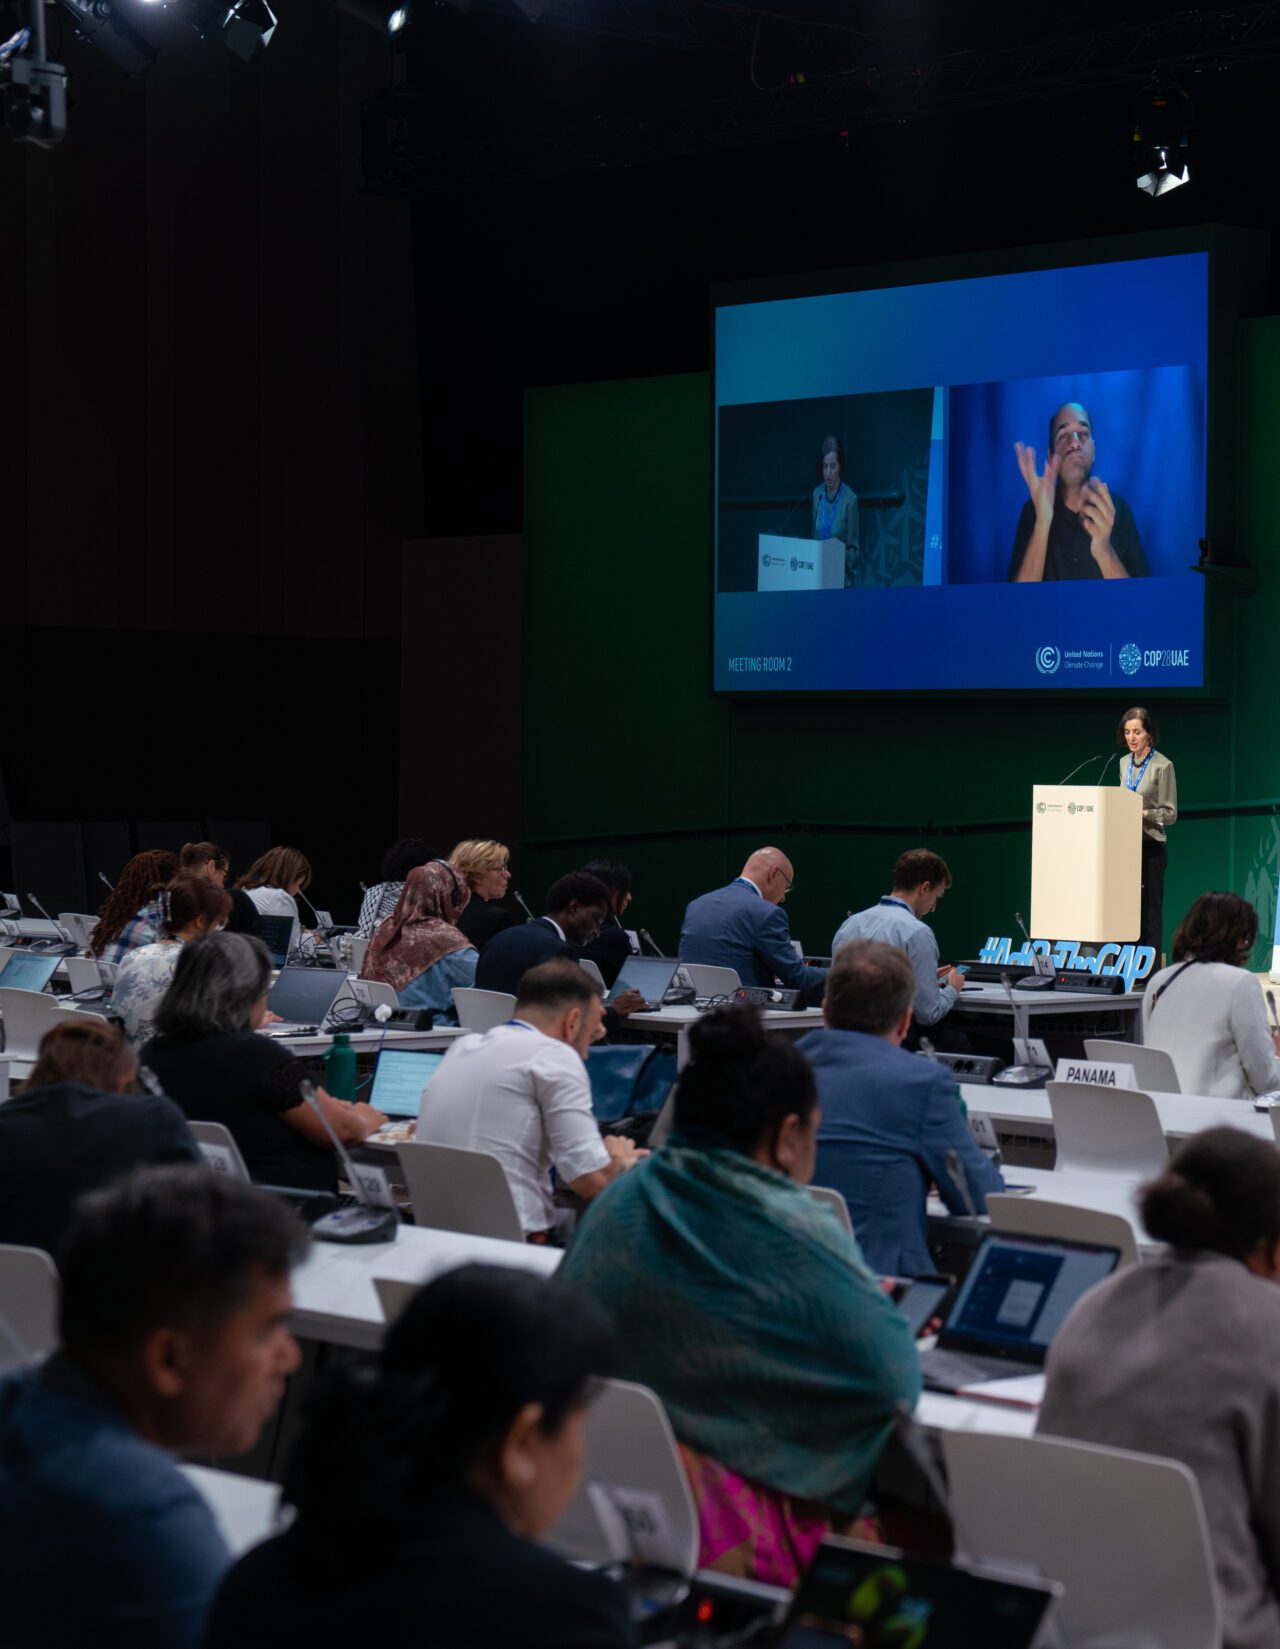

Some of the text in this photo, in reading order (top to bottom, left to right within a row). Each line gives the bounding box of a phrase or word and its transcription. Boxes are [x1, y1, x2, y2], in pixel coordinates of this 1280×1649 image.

[1064, 650, 1103, 658] United Nations
[1143, 650, 1189, 667] COP28UAE
[728, 656, 792, 672] MEETING ROOM 2
[1064, 661, 1103, 671] Climate Change
[1066, 1066, 1116, 1086] PANAMA
